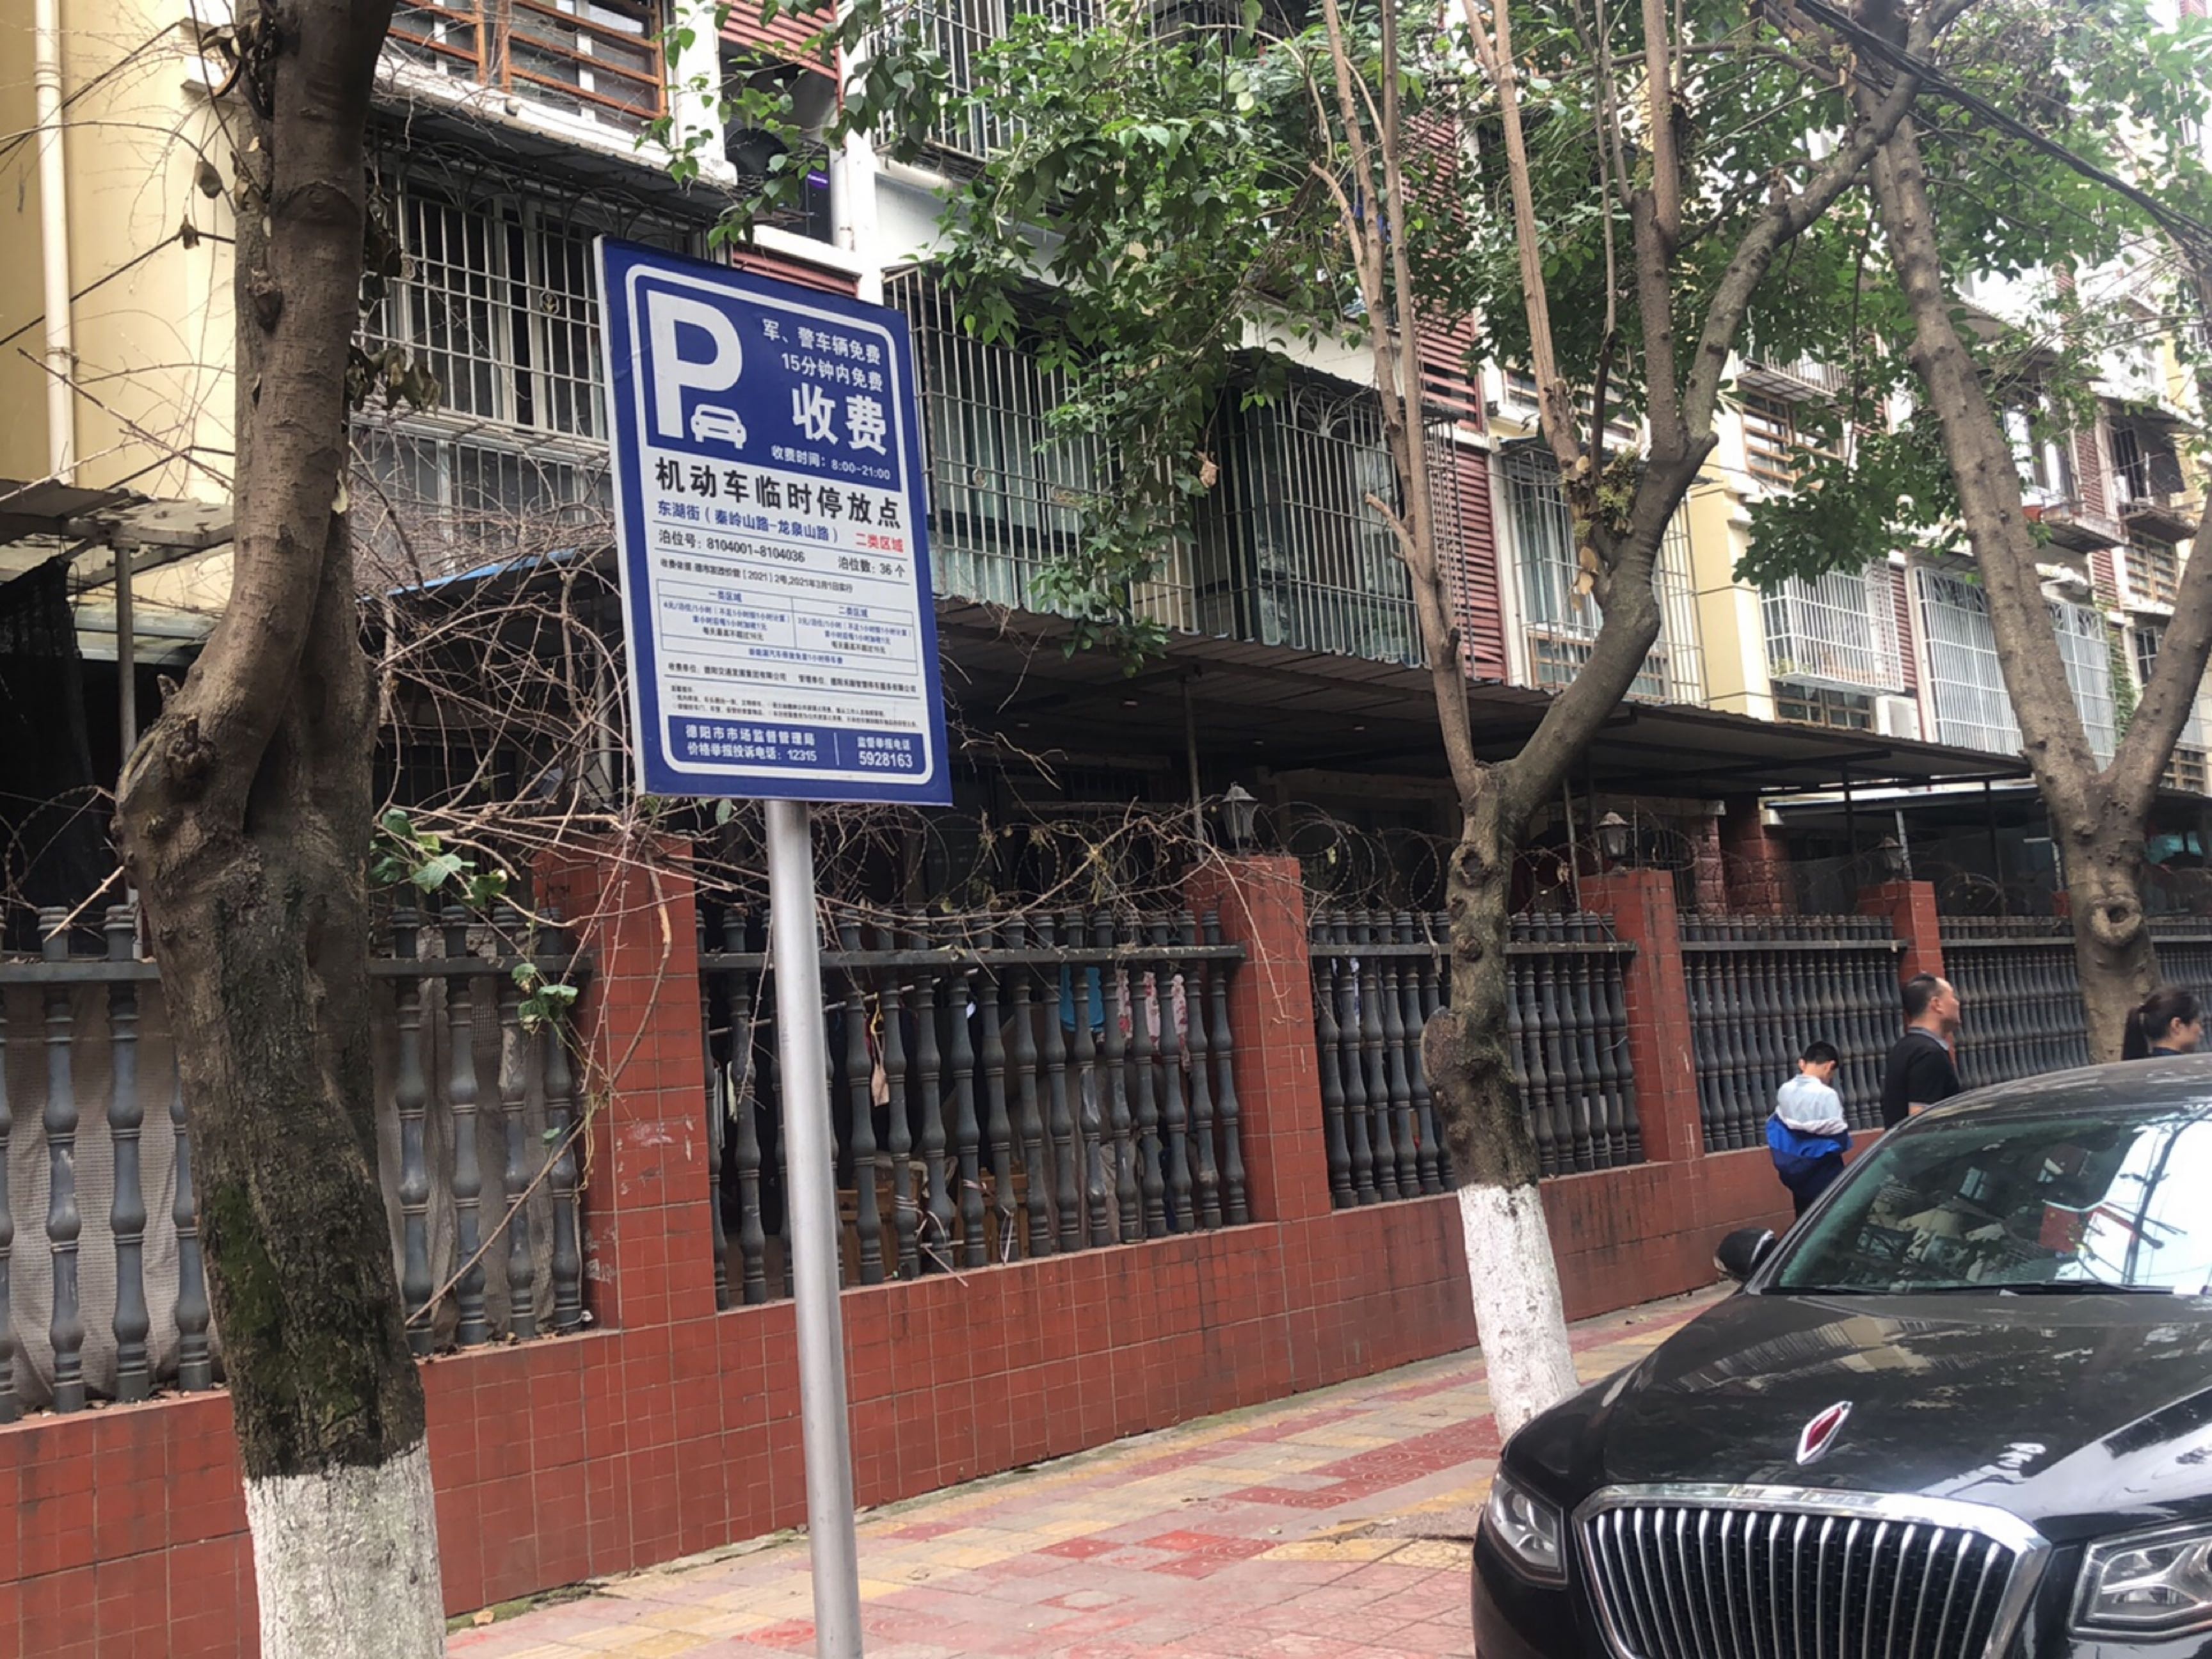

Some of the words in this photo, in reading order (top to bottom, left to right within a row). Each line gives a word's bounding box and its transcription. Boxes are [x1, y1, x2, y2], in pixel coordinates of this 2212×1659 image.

[762, 318, 880, 365] 军、警车辆免费
[646, 289, 742, 438] P
[781, 353, 882, 392] 15分钟内免费
[792, 382, 886, 456] 收费
[655, 456, 901, 529] 机动车临时停放点
[856, 533, 904, 553] 二类区域
[685, 725, 815, 746] 德阳市市场监督管理局
[857, 736, 911, 751] 监督举报电话
[859, 751, 913, 767] 5928163
